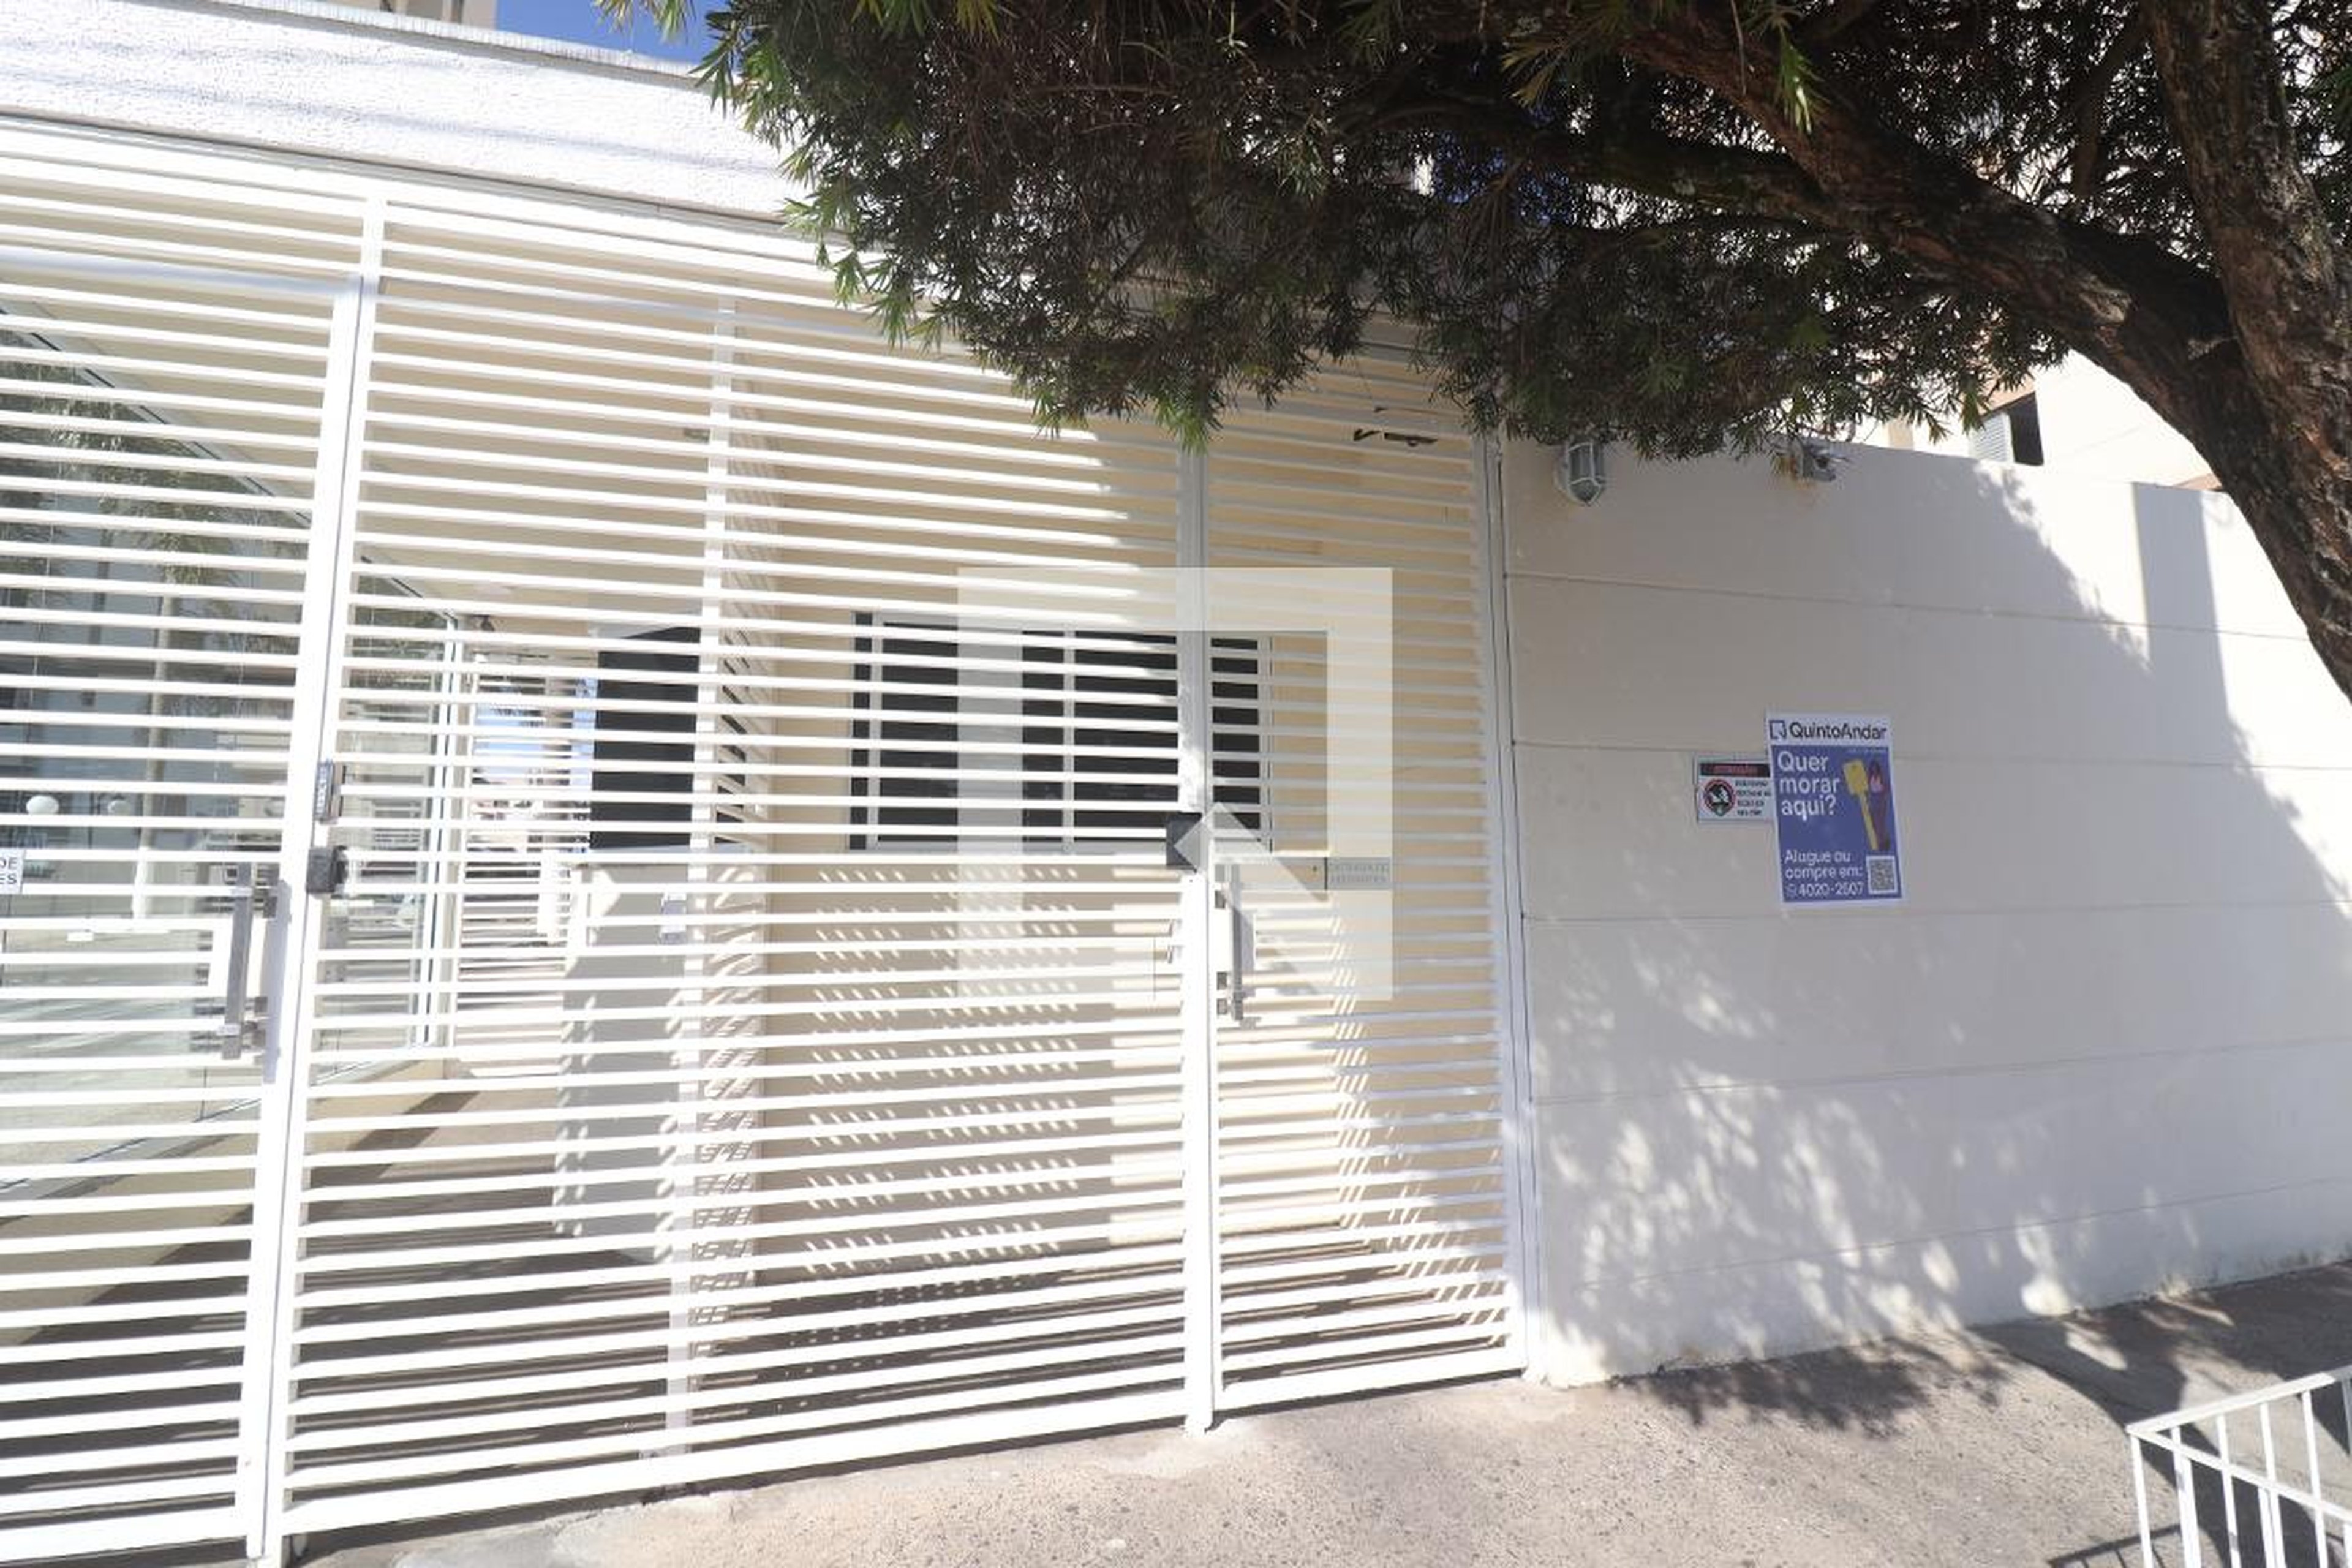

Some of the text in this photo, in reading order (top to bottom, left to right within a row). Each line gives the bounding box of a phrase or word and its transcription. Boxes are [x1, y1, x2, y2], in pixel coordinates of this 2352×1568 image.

[1789, 721, 1887, 740] QuintoAndar
[1777, 751, 1829, 772] Quer
[1779, 778, 1840, 794] morar
[1781, 796, 1837, 821] aqui?
[1784, 849, 1851, 866] Alugue ou
[1785, 866, 1863, 881] compre em:
